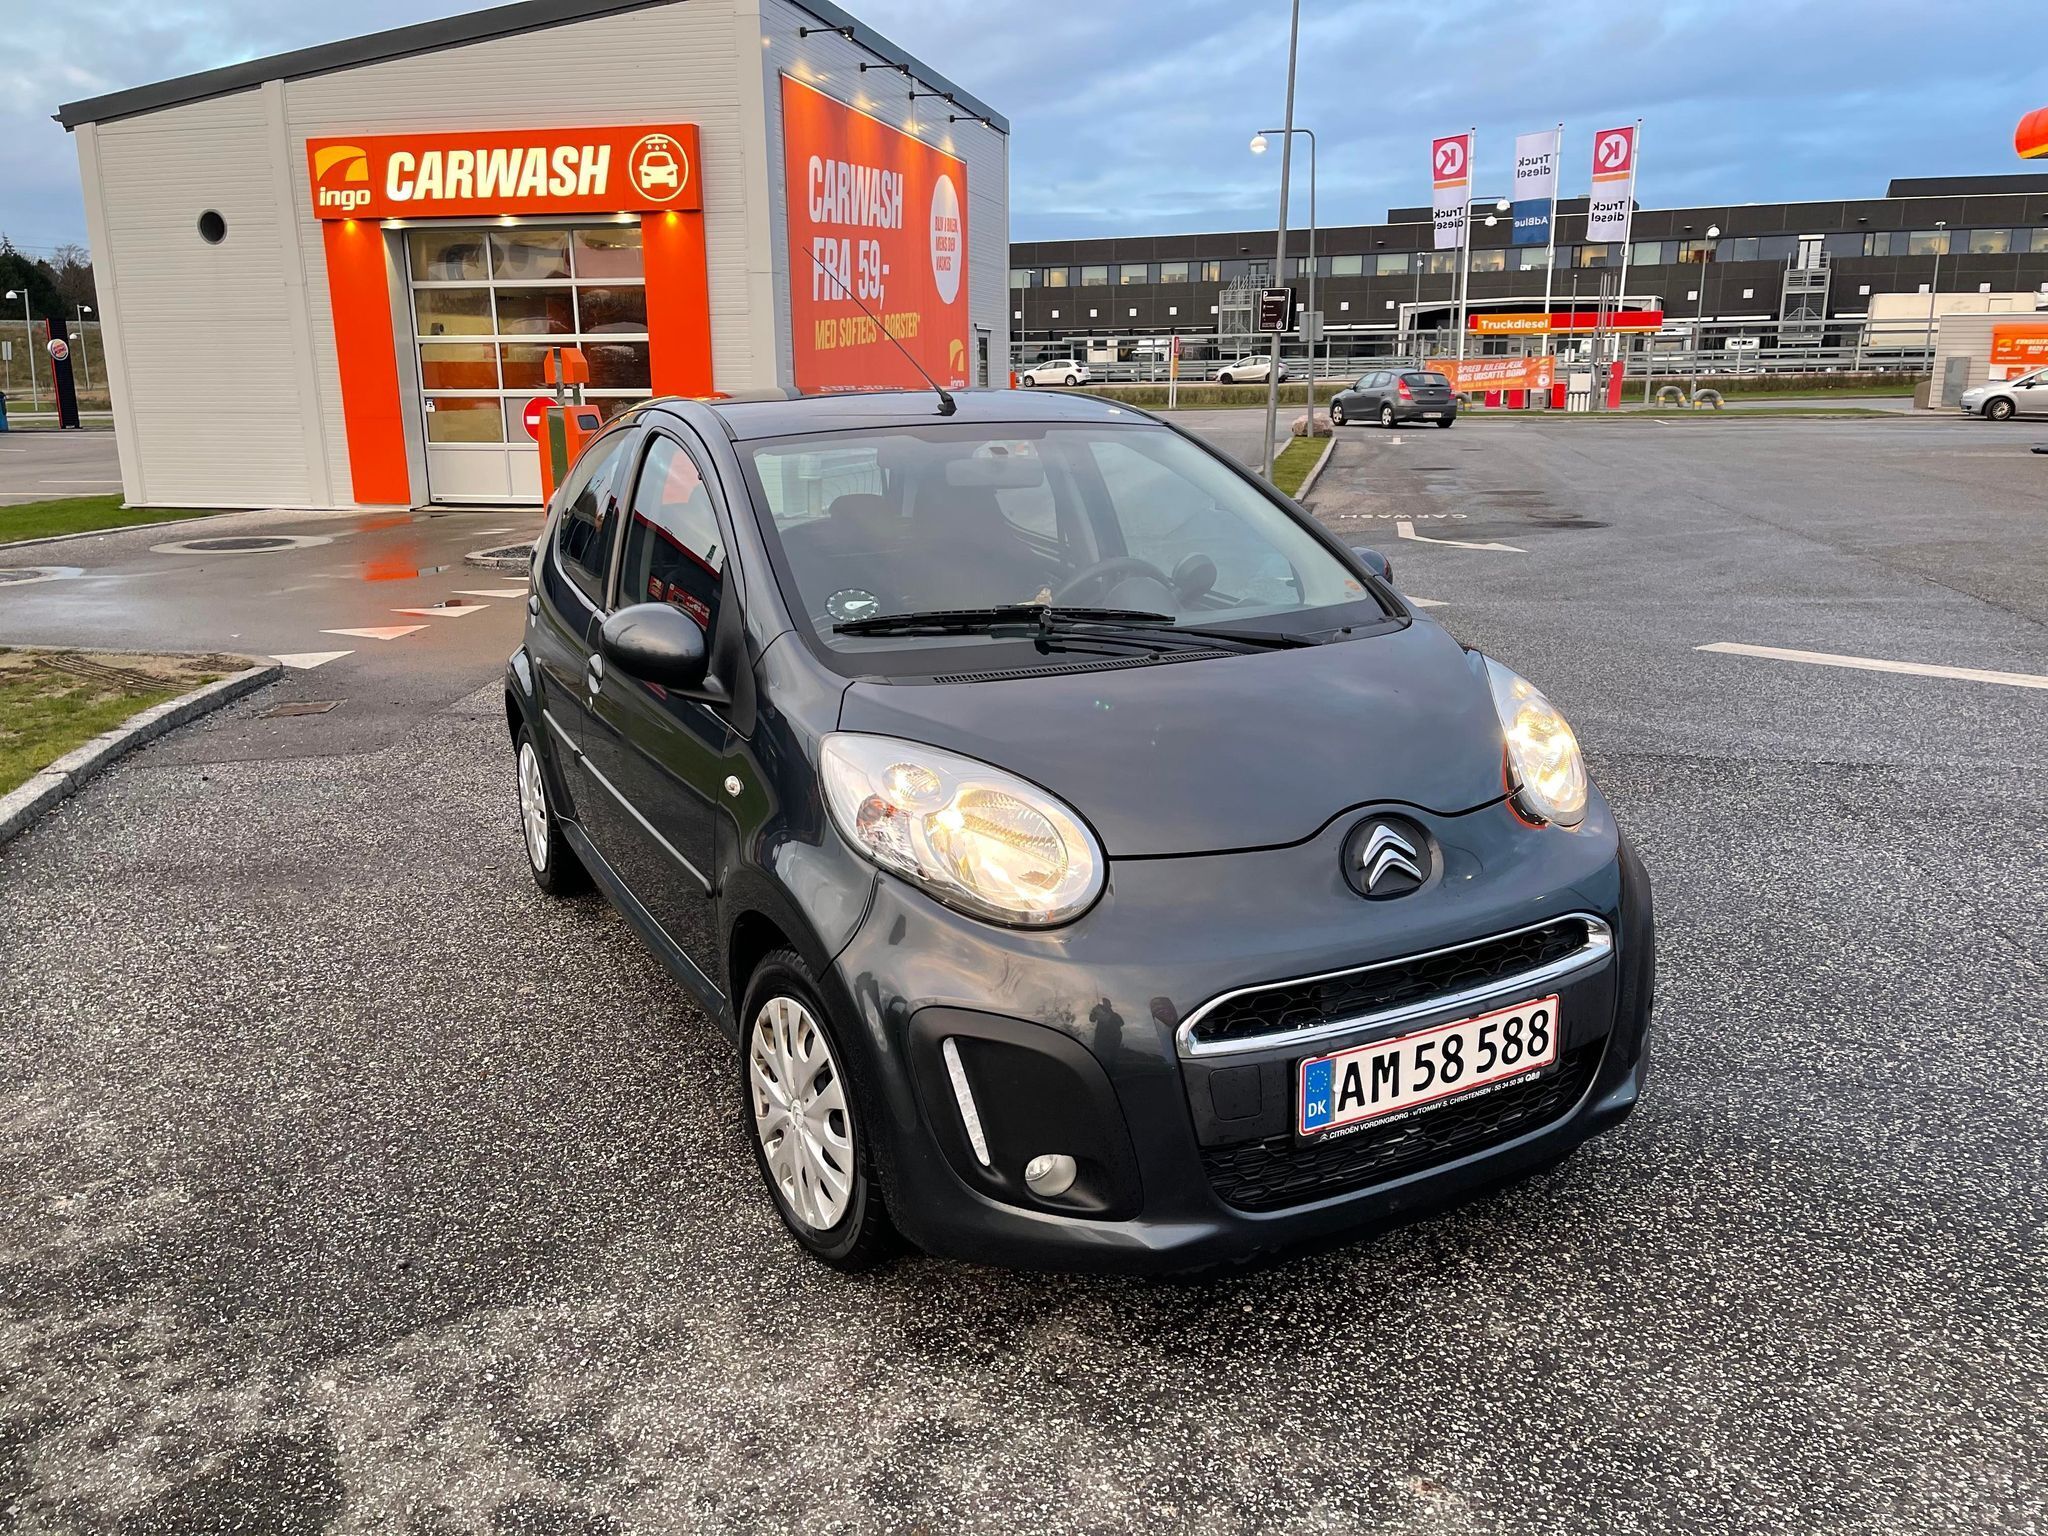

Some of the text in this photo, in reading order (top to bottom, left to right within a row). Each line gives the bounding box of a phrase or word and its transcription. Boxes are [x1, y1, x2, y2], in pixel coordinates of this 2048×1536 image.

[385, 145, 611, 201] CARWASH
[808, 155, 903, 229] CARWASH
[319, 186, 371, 211] ingo
[813, 237, 852, 301] FRA
[815, 319, 837, 351] MED
[1481, 319, 1548, 329] Truckdiesel
[1337, 1009, 1549, 1112] AM 58 588
[1308, 1100, 1327, 1118] DK
[1360, 1111, 1409, 1130] VORDINGBORG
[1449, 1087, 1492, 1105] CHRISTENSEN
